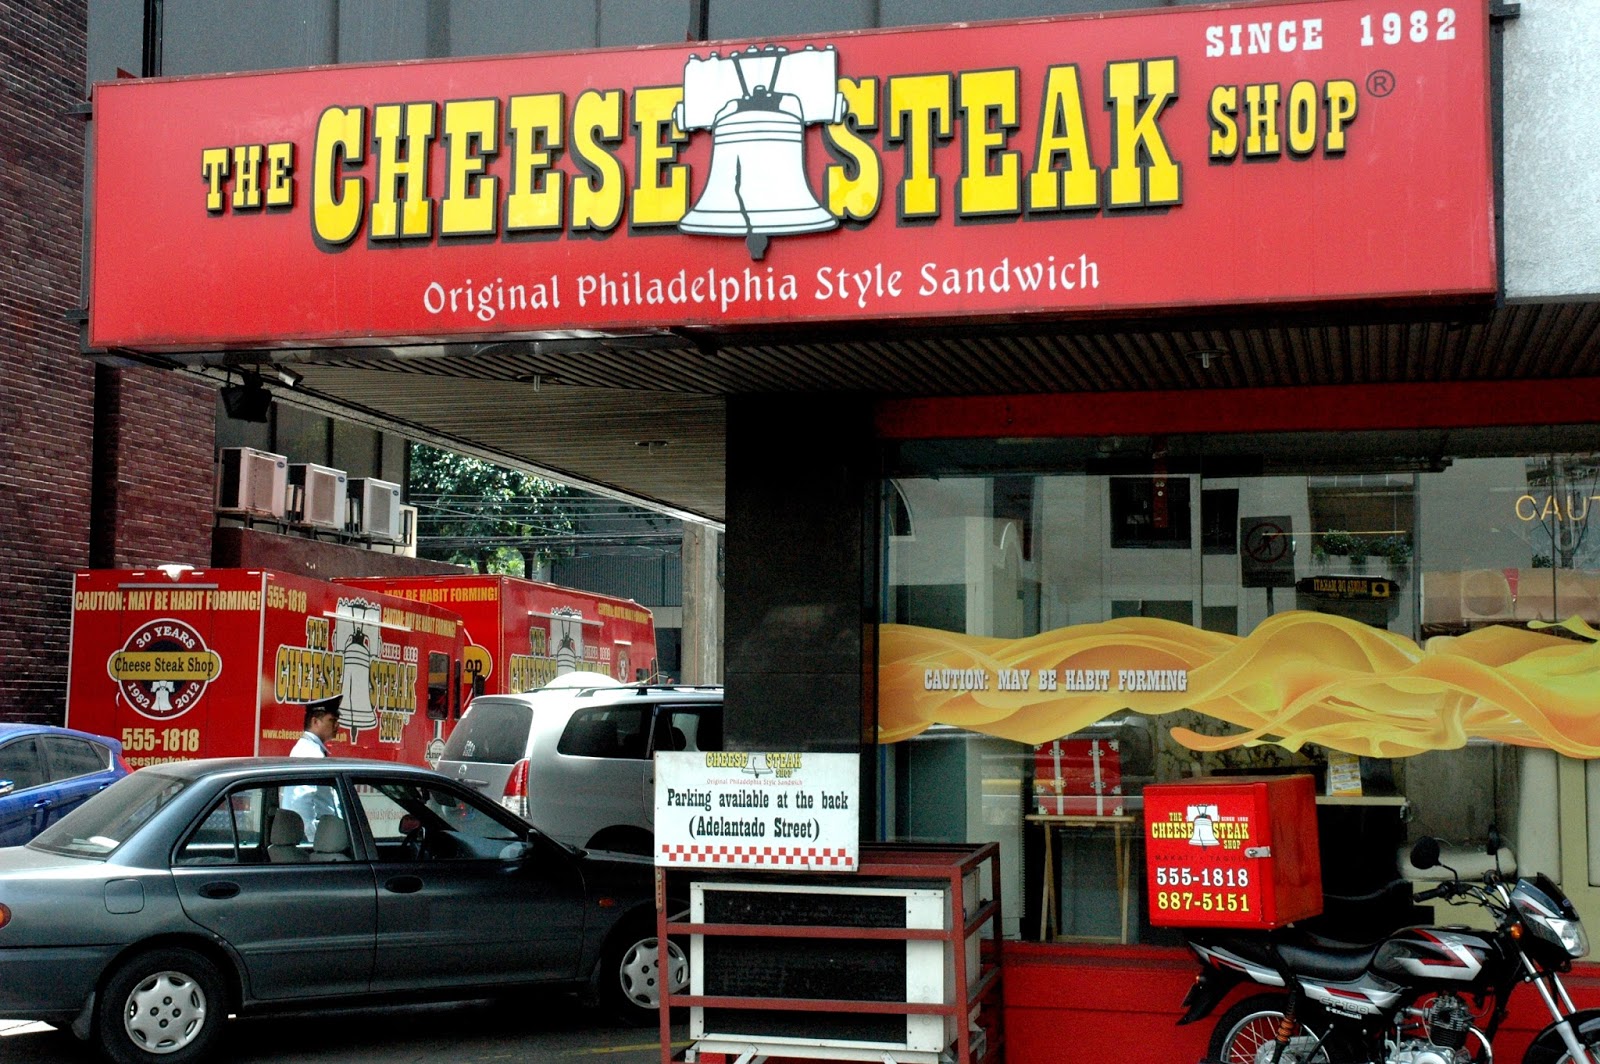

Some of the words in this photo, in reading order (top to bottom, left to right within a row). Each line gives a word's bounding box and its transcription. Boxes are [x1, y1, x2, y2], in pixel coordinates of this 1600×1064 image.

[1206, 18, 1323, 58] SINCE
[1360, 8, 1456, 46] 1982
[202, 142, 293, 212] THE
[313, 86, 691, 246] CHEESE
[823, 56, 1182, 221] STEAK
[1209, 79, 1358, 160] SHOP
[423, 274, 561, 322] Original
[576, 266, 799, 314] Philadelphia
[815, 258, 904, 308] Style
[919, 254, 1100, 296] Sandwich
[75, 591, 126, 611] CAUTION:
[128, 591, 153, 611] MAY
[154, 591, 168, 611] BE
[170, 591, 206, 611] HABIT
[206, 590, 261, 611] FORMING!
[267, 584, 307, 614] 555-1818
[406, 589, 418, 602] BE
[420, 588, 449, 603] HABIT
[450, 587, 498, 602] FORMING!
[136, 631, 152, 648] 30
[154, 626, 196, 649] YEARS
[306, 616, 329, 650] THE
[114, 657, 151, 672] Cheese
[154, 657, 185, 673] Steak
[187, 657, 214, 677] Shop
[276, 645, 344, 704] CHEESE
[369, 660, 417, 713] STEAK
[924, 669, 989, 691] CAUTION:
[998, 669, 1031, 691] MAY
[1038, 669, 1057, 691] BE
[1065, 670, 1110, 691] HABIT
[1118, 670, 1187, 692] FORMING
[127, 682, 151, 709] 1982
[175, 681, 200, 709] 2012
[122, 727, 200, 752] 555-1818
[706, 752, 749, 768] CHEESE
[765, 752, 802, 768] STEAK
[668, 788, 711, 811] Parking
[719, 789, 769, 808] available
[777, 791, 788, 809] at
[795, 790, 813, 809] the
[822, 791, 849, 809] back
[688, 815, 765, 839] (Adelantado
[774, 817, 820, 842] Street)
[1169, 812, 1182, 822] THE
[1151, 822, 1194, 839] CHEESE
[1212, 822, 1250, 839] STEAK
[1223, 839, 1241, 850] SHOP
[1156, 867, 1248, 887] 555-1818
[1158, 891, 1249, 912] 887-5151
